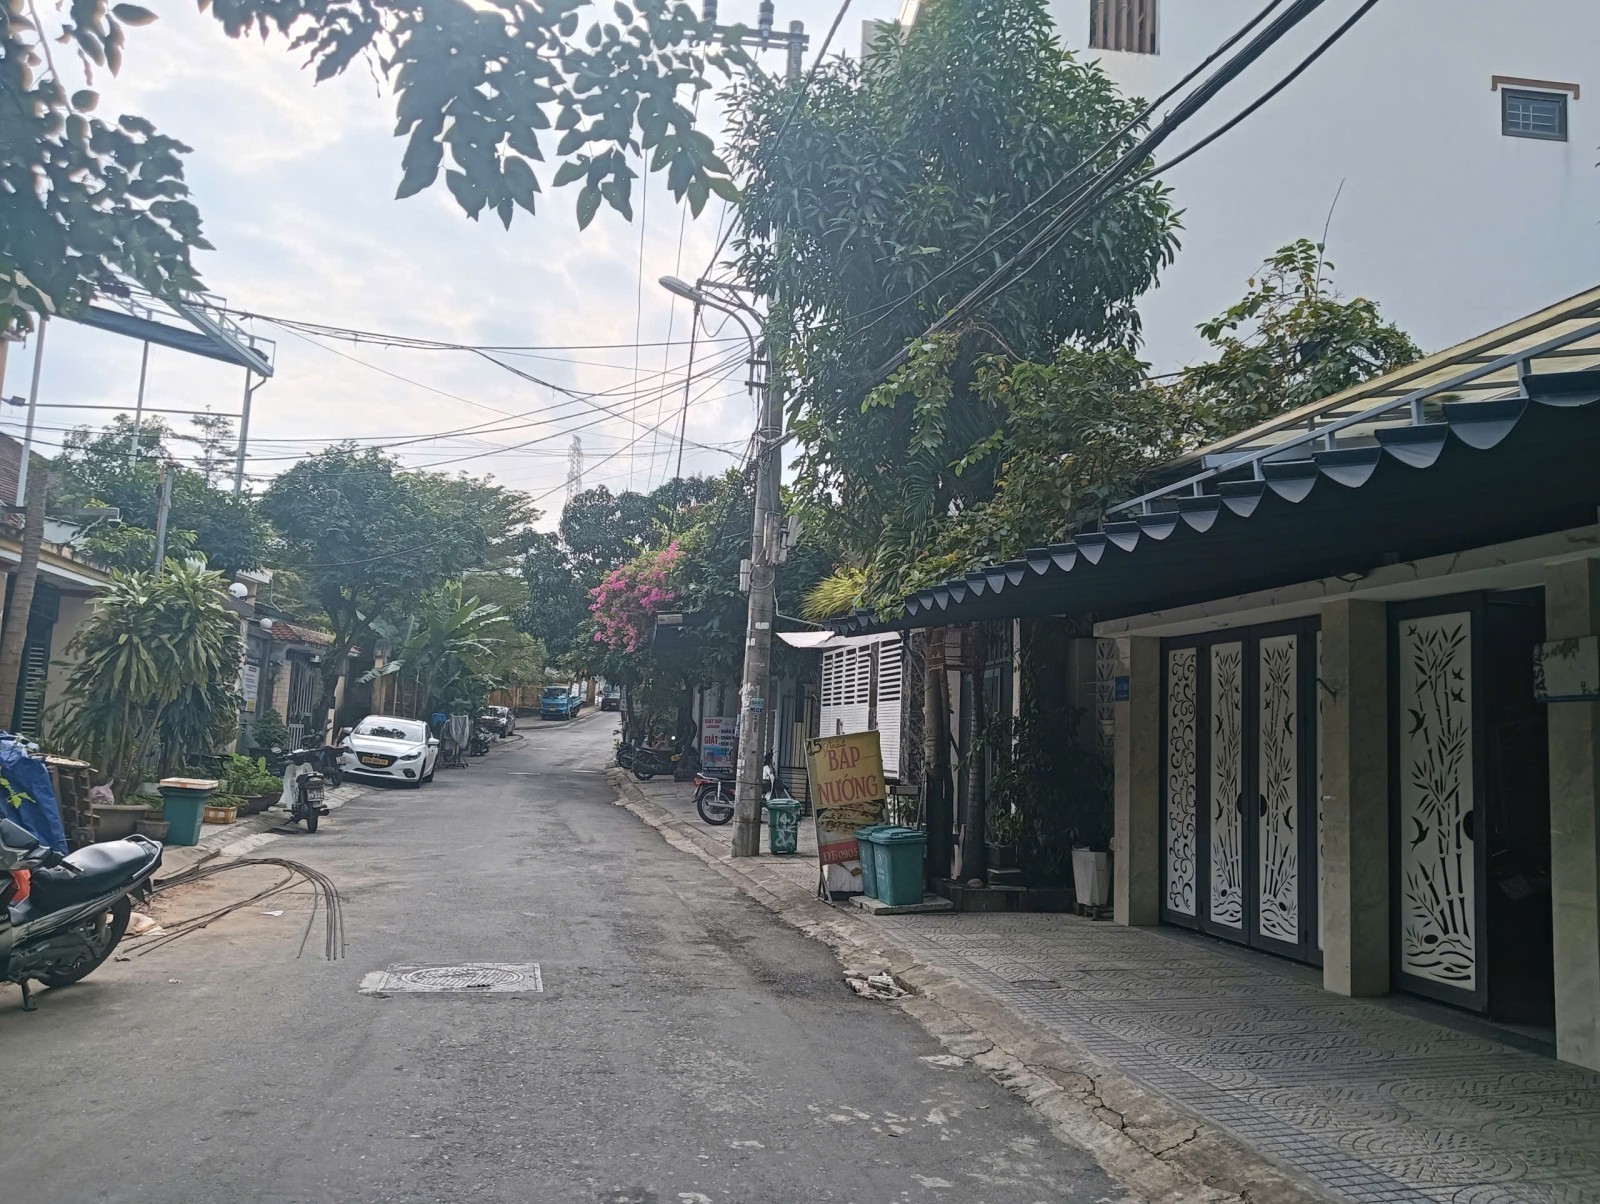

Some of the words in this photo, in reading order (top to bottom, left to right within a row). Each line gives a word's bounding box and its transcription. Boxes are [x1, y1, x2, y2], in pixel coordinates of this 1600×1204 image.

[704, 733, 718, 746] GIẶT
[828, 740, 861, 771] BẮP
[817, 773, 879, 805] NƯỚNG
